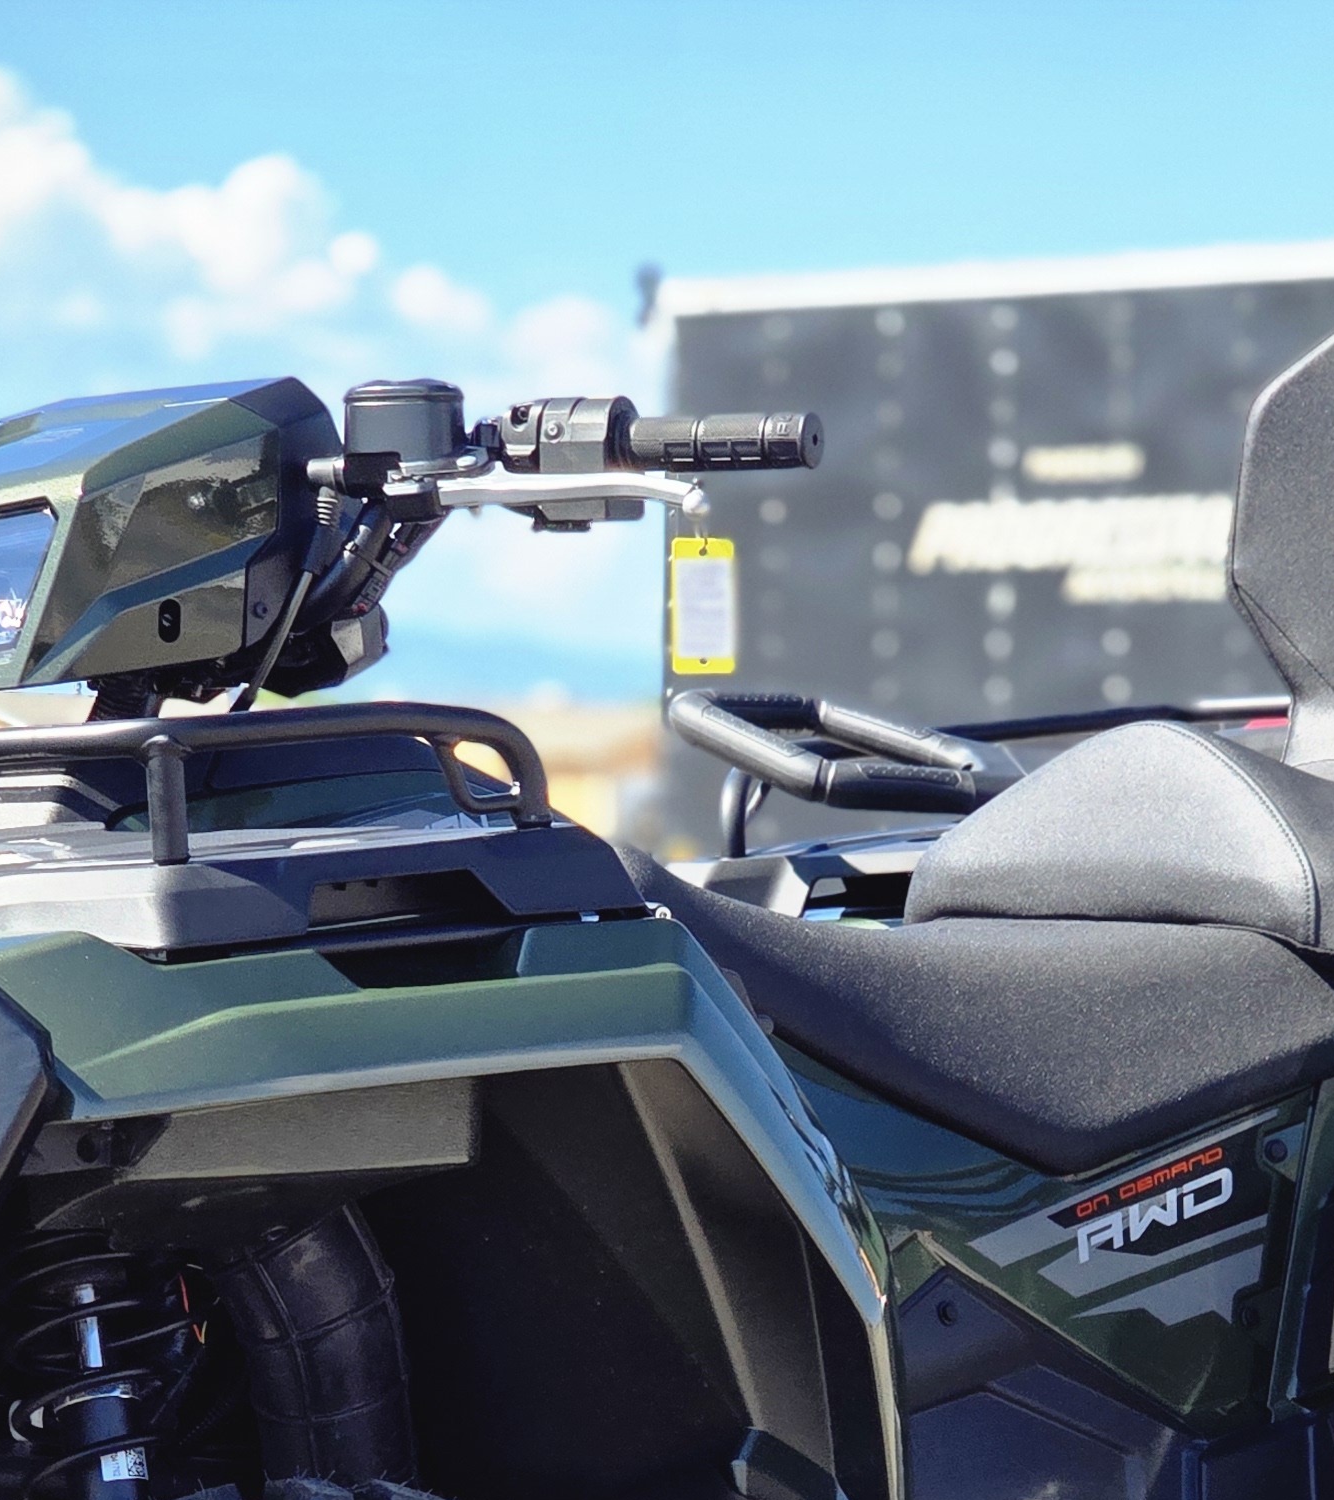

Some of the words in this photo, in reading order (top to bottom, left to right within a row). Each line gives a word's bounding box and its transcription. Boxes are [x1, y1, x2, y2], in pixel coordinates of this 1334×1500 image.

[1076, 1194, 1109, 1218] ON
[1119, 1147, 1223, 1200] DEMAND
[1077, 1167, 1233, 1264] AWD
